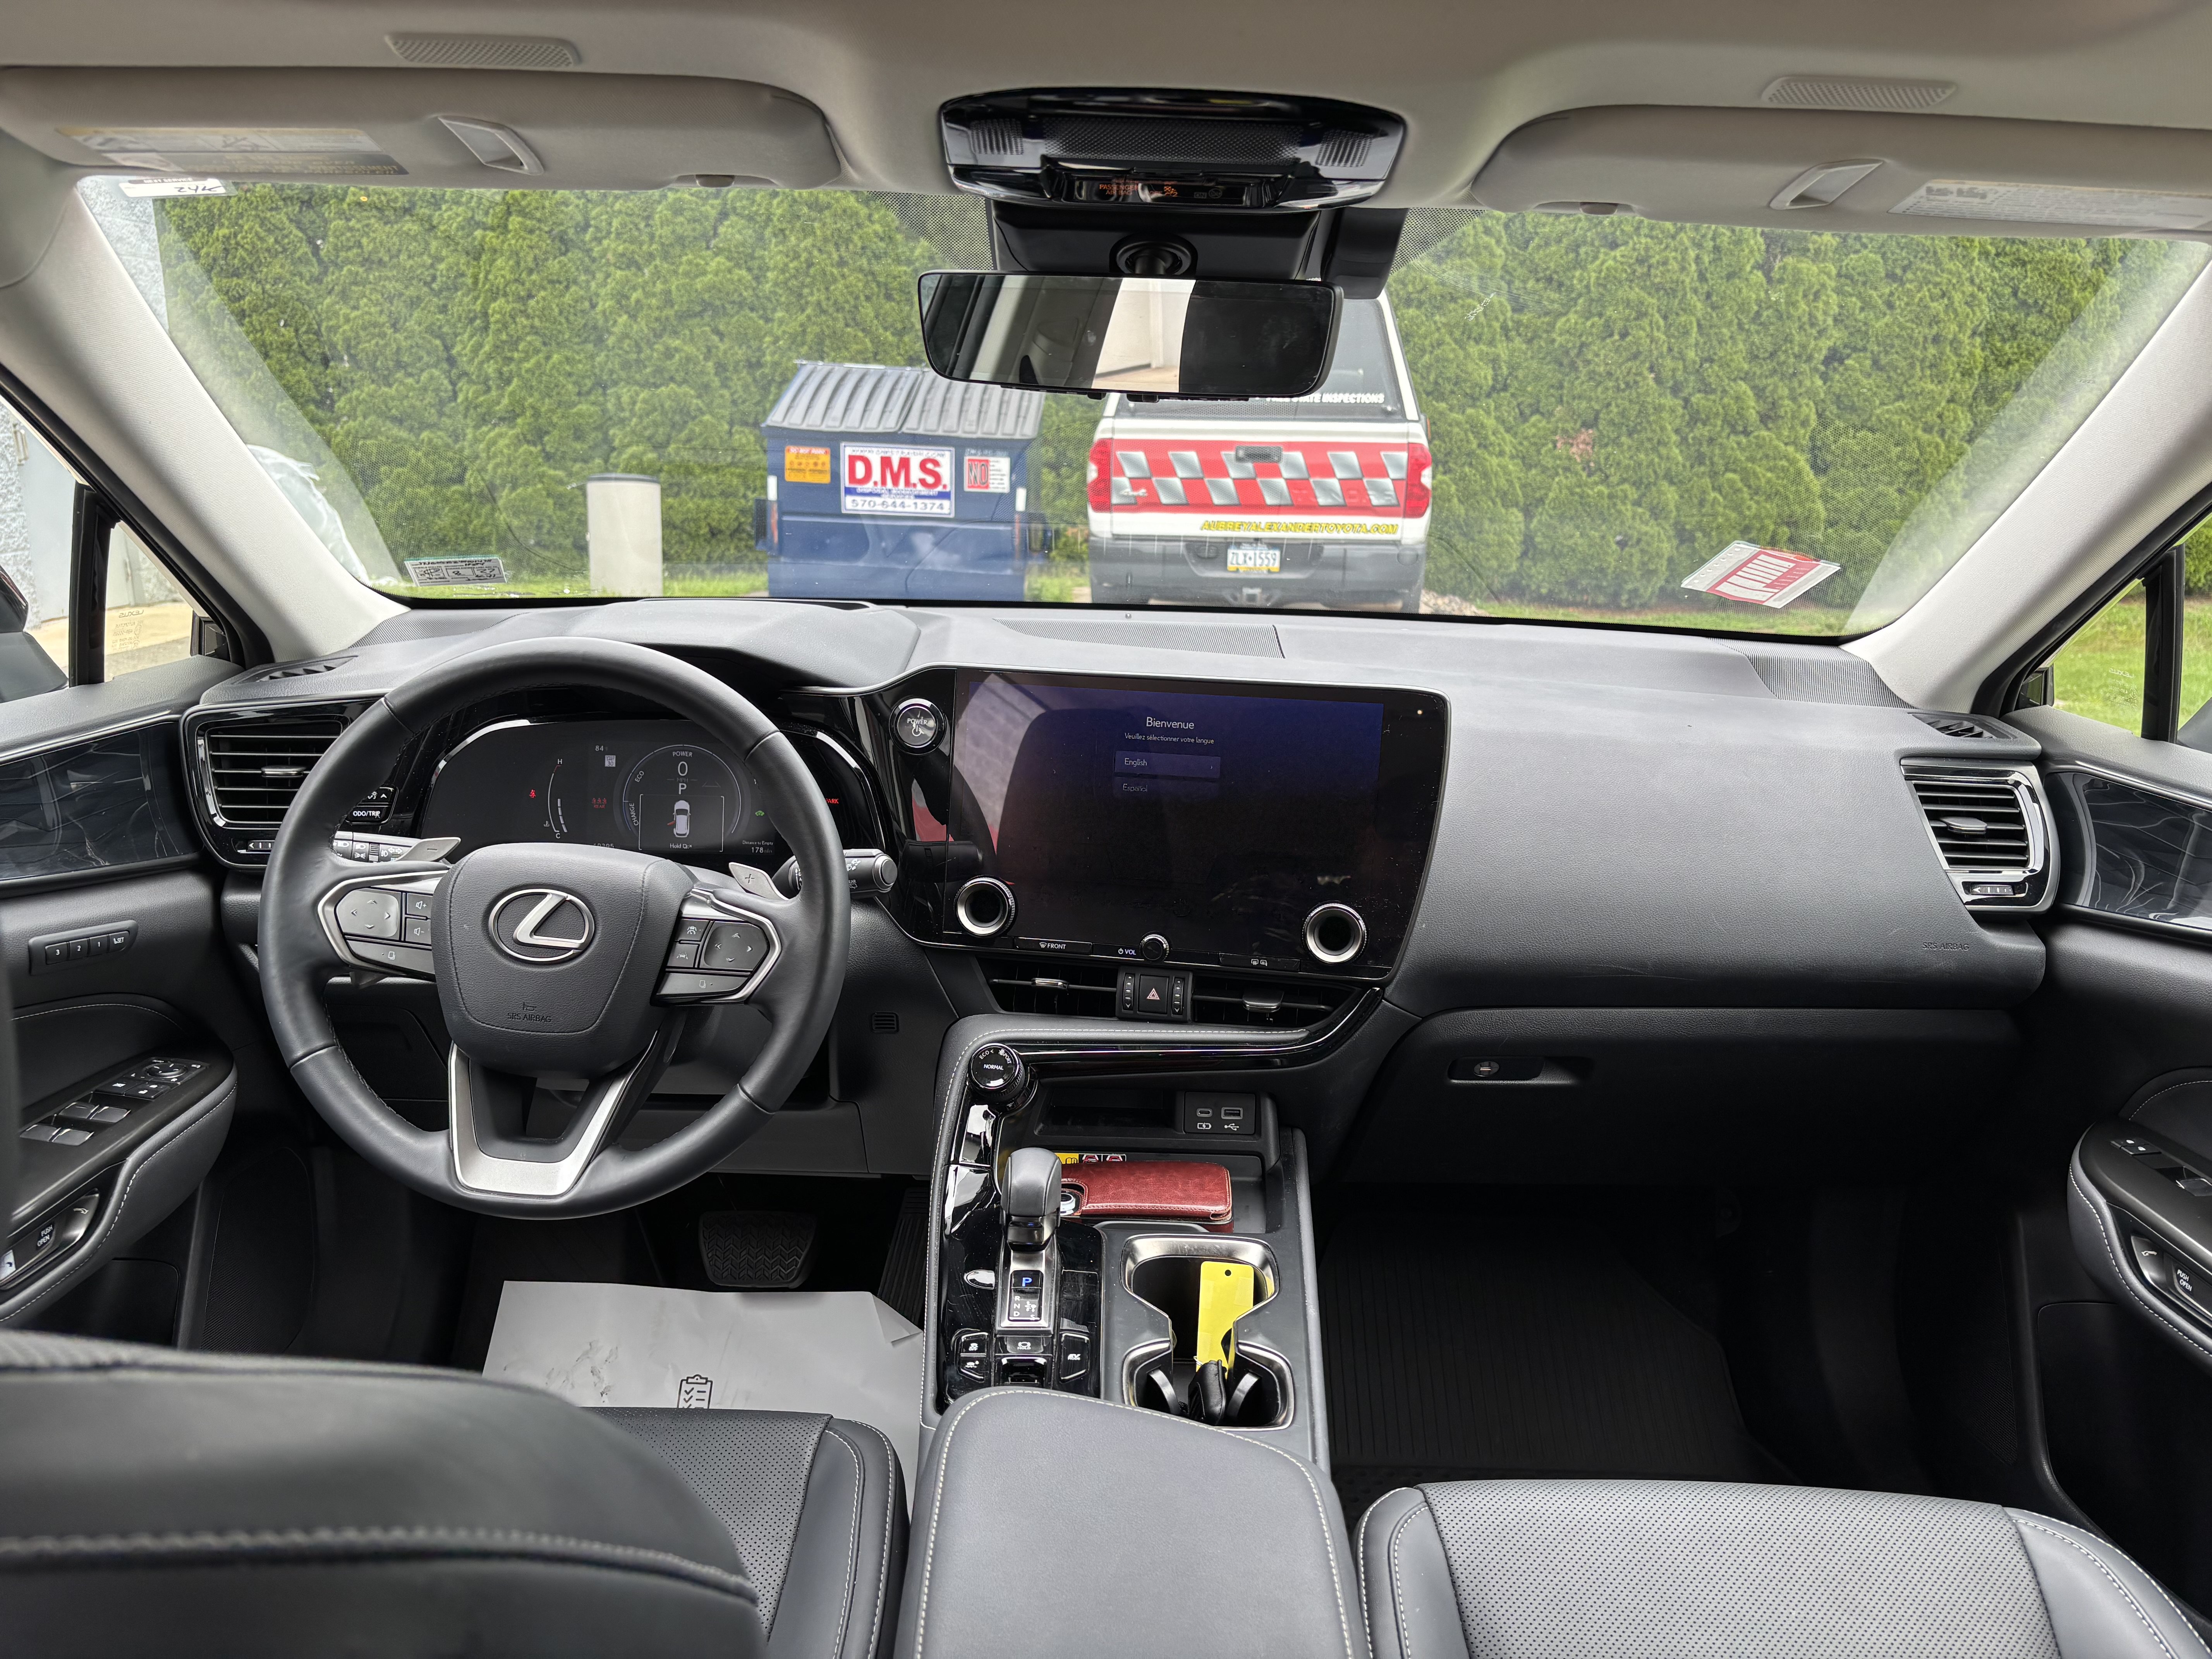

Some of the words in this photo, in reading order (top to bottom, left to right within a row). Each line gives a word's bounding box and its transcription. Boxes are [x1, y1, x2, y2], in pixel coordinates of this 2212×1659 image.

[1322, 393, 1385, 404] INSPECTIONS
[848, 454, 948, 490] D.M.S.
[969, 462, 988, 486] NO
[851, 499, 945, 511] 570-644-1374
[1200, 520, 1399, 534] AUBREYALEXANDERTOYOTA.COM
[1146, 716, 1195, 729] Bienvenue
[1196, 737, 1214, 745] langue
[678, 761, 688, 776] 0
[1124, 758, 1147, 767] English
[634, 771, 644, 783] ECO
[678, 783, 687, 794] P
[1123, 783, 1147, 792] Español
[629, 803, 639, 826] CHARGE
[522, 1014, 551, 1023] AIRBAG
[979, 1050, 989, 1060] ECO
[41, 1224, 53, 1237] PUSH
[37, 1234, 50, 1247] OPEN
[2177, 1269, 2189, 1281] PUSH
[1022, 1277, 1032, 1287] P
[2179, 1279, 2192, 1291] OPEN
